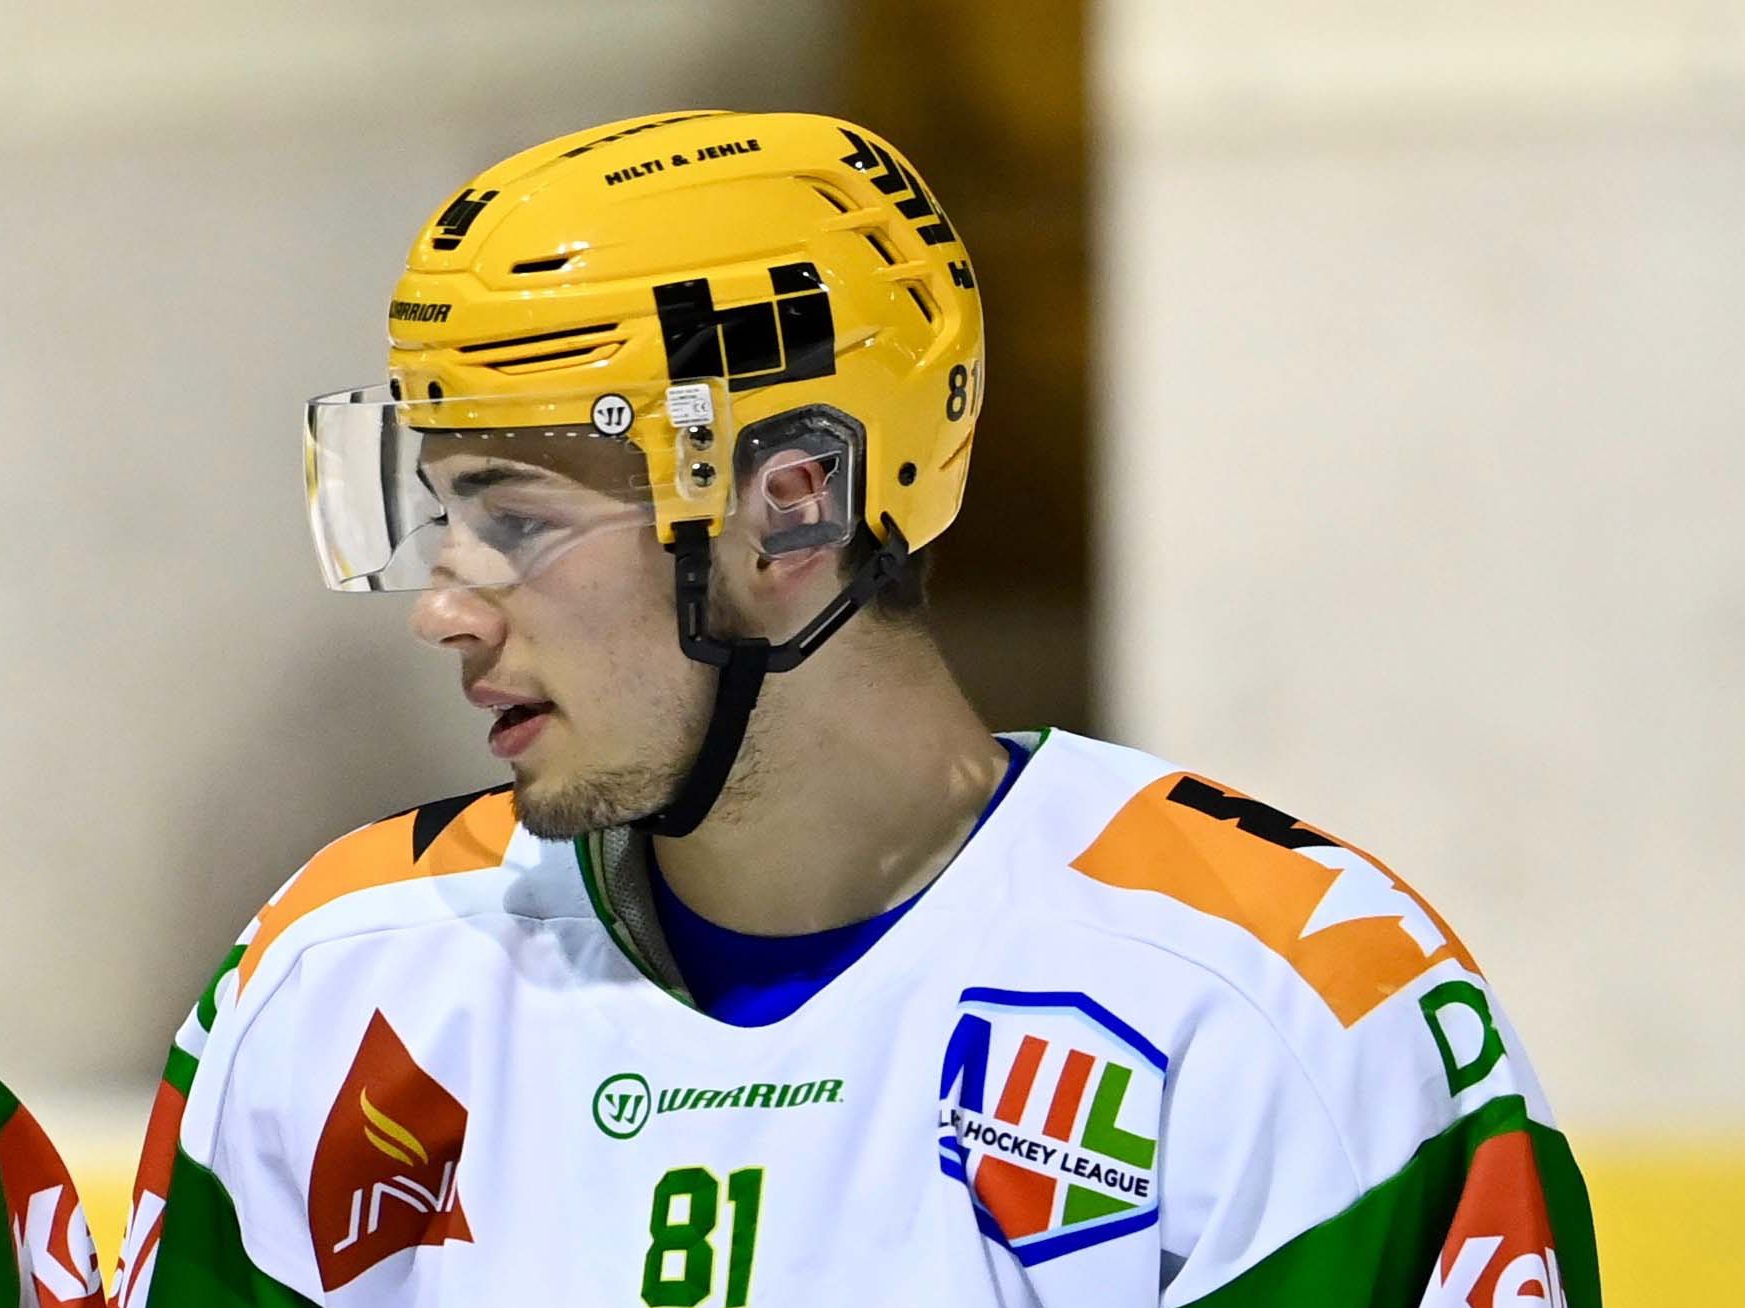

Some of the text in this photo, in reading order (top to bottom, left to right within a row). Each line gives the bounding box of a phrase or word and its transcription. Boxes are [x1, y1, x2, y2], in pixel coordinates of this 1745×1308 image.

[604, 138, 762, 187] HILTI & JEHLE
[963, 1119, 1058, 1166] HOCKEY
[1059, 1152, 1151, 1199] LEAGUE
